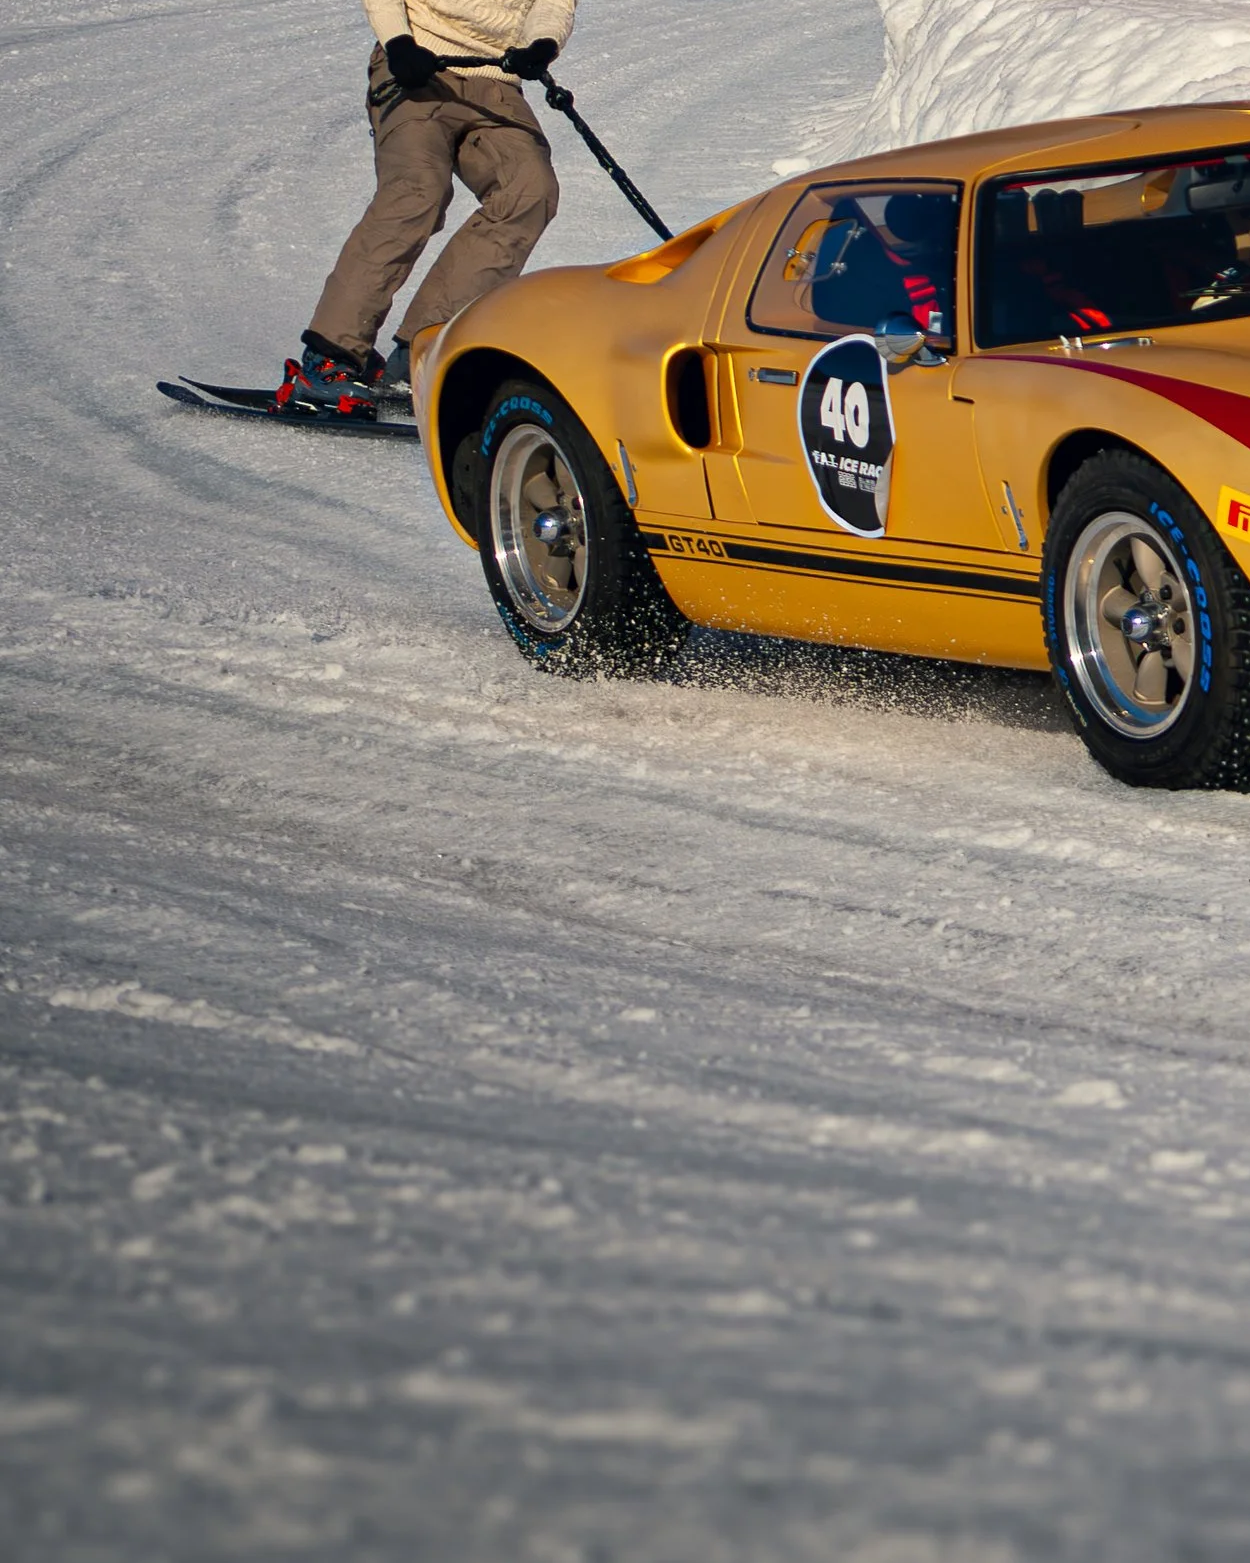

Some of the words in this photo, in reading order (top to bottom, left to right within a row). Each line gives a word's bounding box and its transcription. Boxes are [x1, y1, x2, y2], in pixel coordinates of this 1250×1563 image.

[820, 376, 870, 448] 40
[839, 456, 859, 472] ICE
[668, 534, 724, 557] GT40
[1150, 501, 1212, 692] ICE-CROSS
